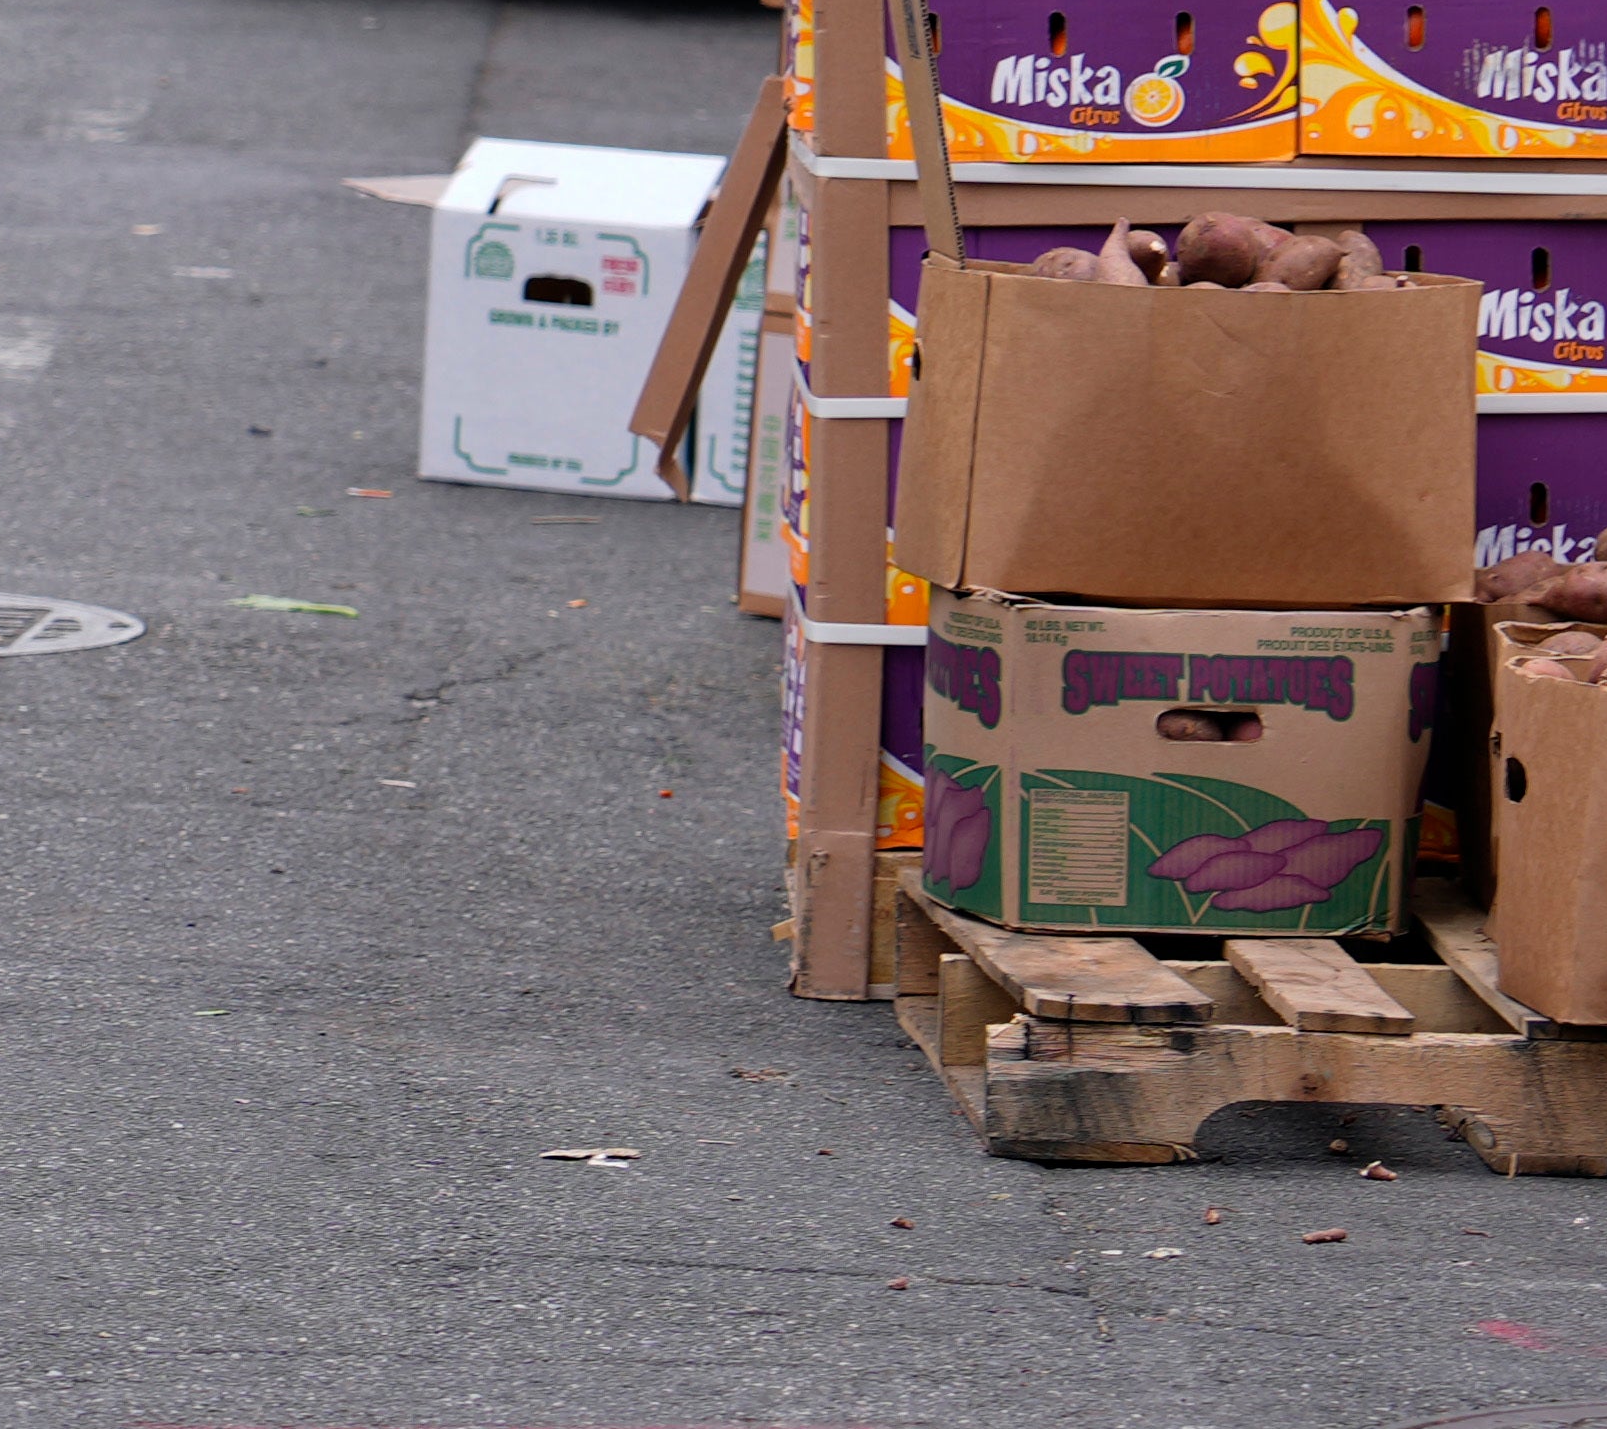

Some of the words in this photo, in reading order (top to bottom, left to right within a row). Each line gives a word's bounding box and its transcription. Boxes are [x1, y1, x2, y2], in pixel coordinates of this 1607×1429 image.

[991, 53, 1121, 109] Miska
[1070, 105, 1121, 125] Citrus
[1477, 288, 1606, 343] Miska
[1552, 341, 1606, 363] Citrus
[1257, 639, 1305, 651] PRODUIT
[1308, 640, 1330, 652] DES
[1290, 627, 1340, 639] PRODUCT
[1345, 628, 1361, 639] OF
[1063, 649, 1185, 715] SWEET
[1187, 653, 1355, 722] POTATOES
